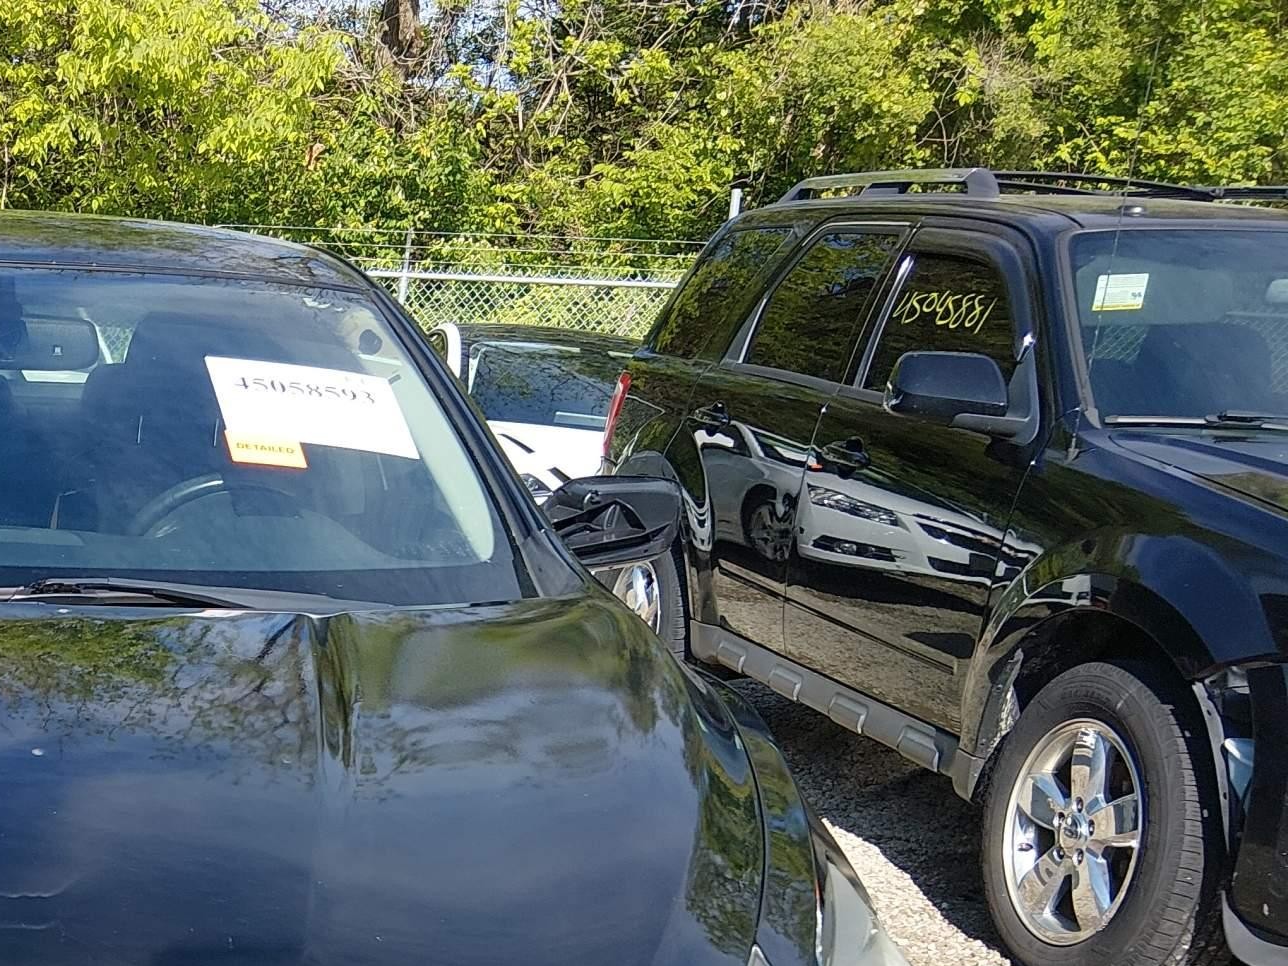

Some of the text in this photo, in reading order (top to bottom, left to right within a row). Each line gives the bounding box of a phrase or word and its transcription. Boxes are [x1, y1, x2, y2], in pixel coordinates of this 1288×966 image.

[892, 289, 996, 334] 45045881
[234, 376, 376, 404] 45058593
[235, 441, 295, 455] DETAILED
